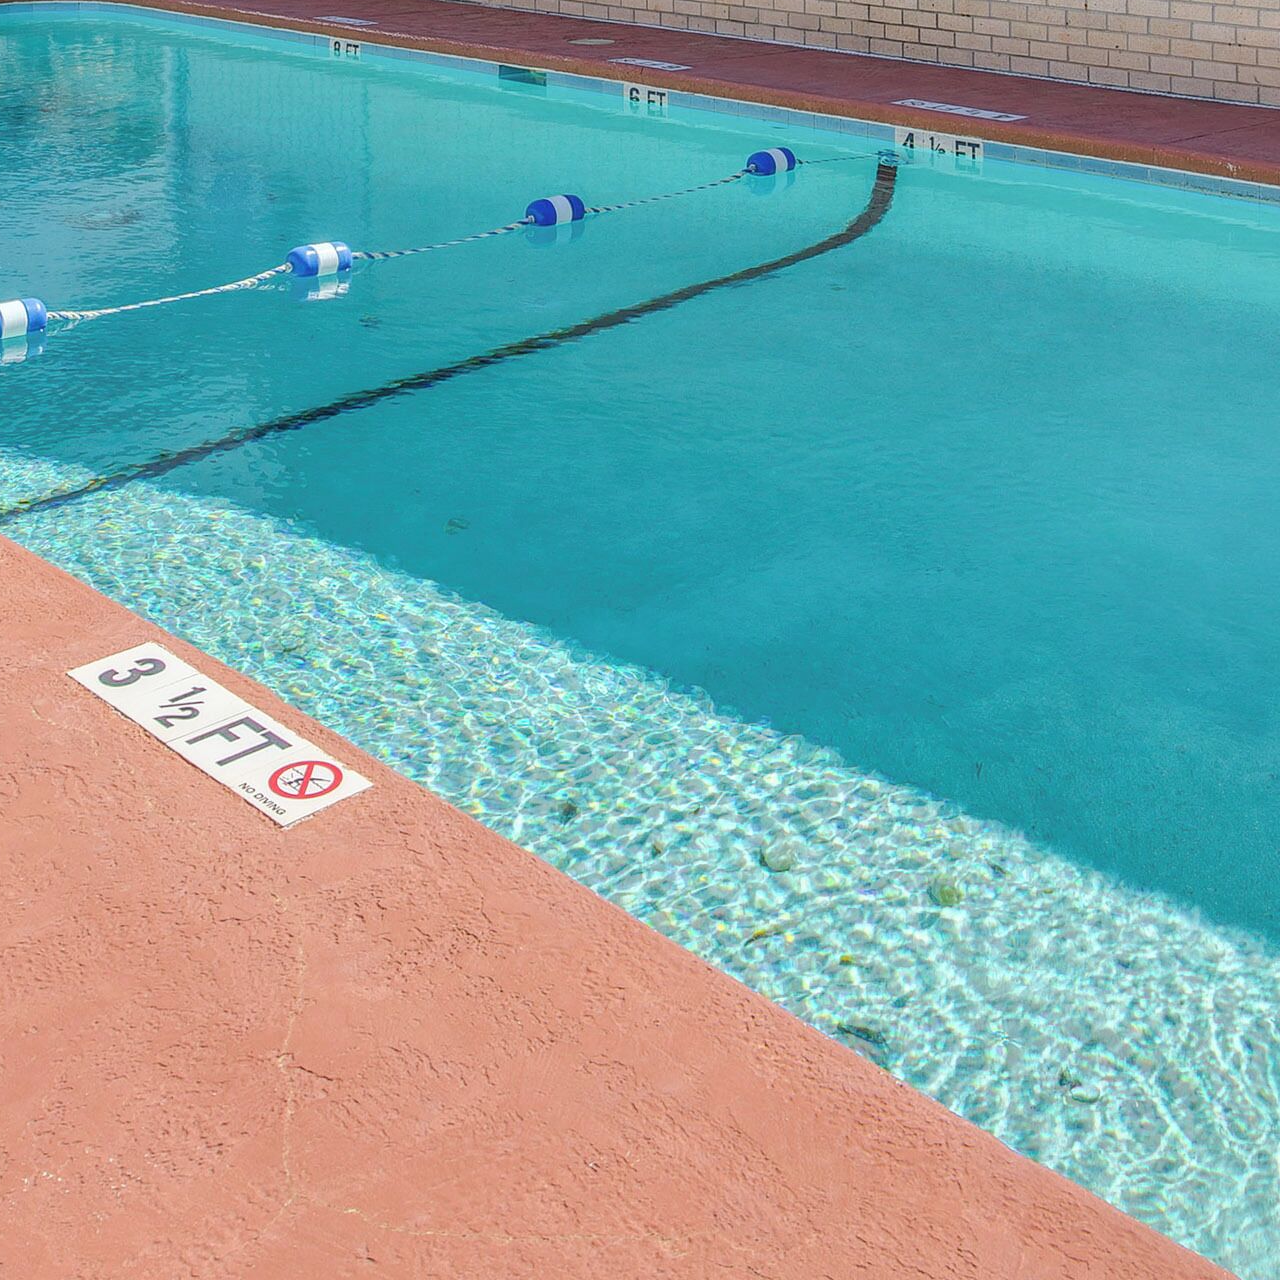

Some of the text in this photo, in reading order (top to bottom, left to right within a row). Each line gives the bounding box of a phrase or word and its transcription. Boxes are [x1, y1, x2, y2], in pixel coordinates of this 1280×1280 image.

[629, 87, 666, 106] 6 FT
[955, 140, 980, 160] FT
[98, 657, 167, 687] 3
[185, 716, 294, 767] FT
[238, 782, 286, 815] NO DIVING
